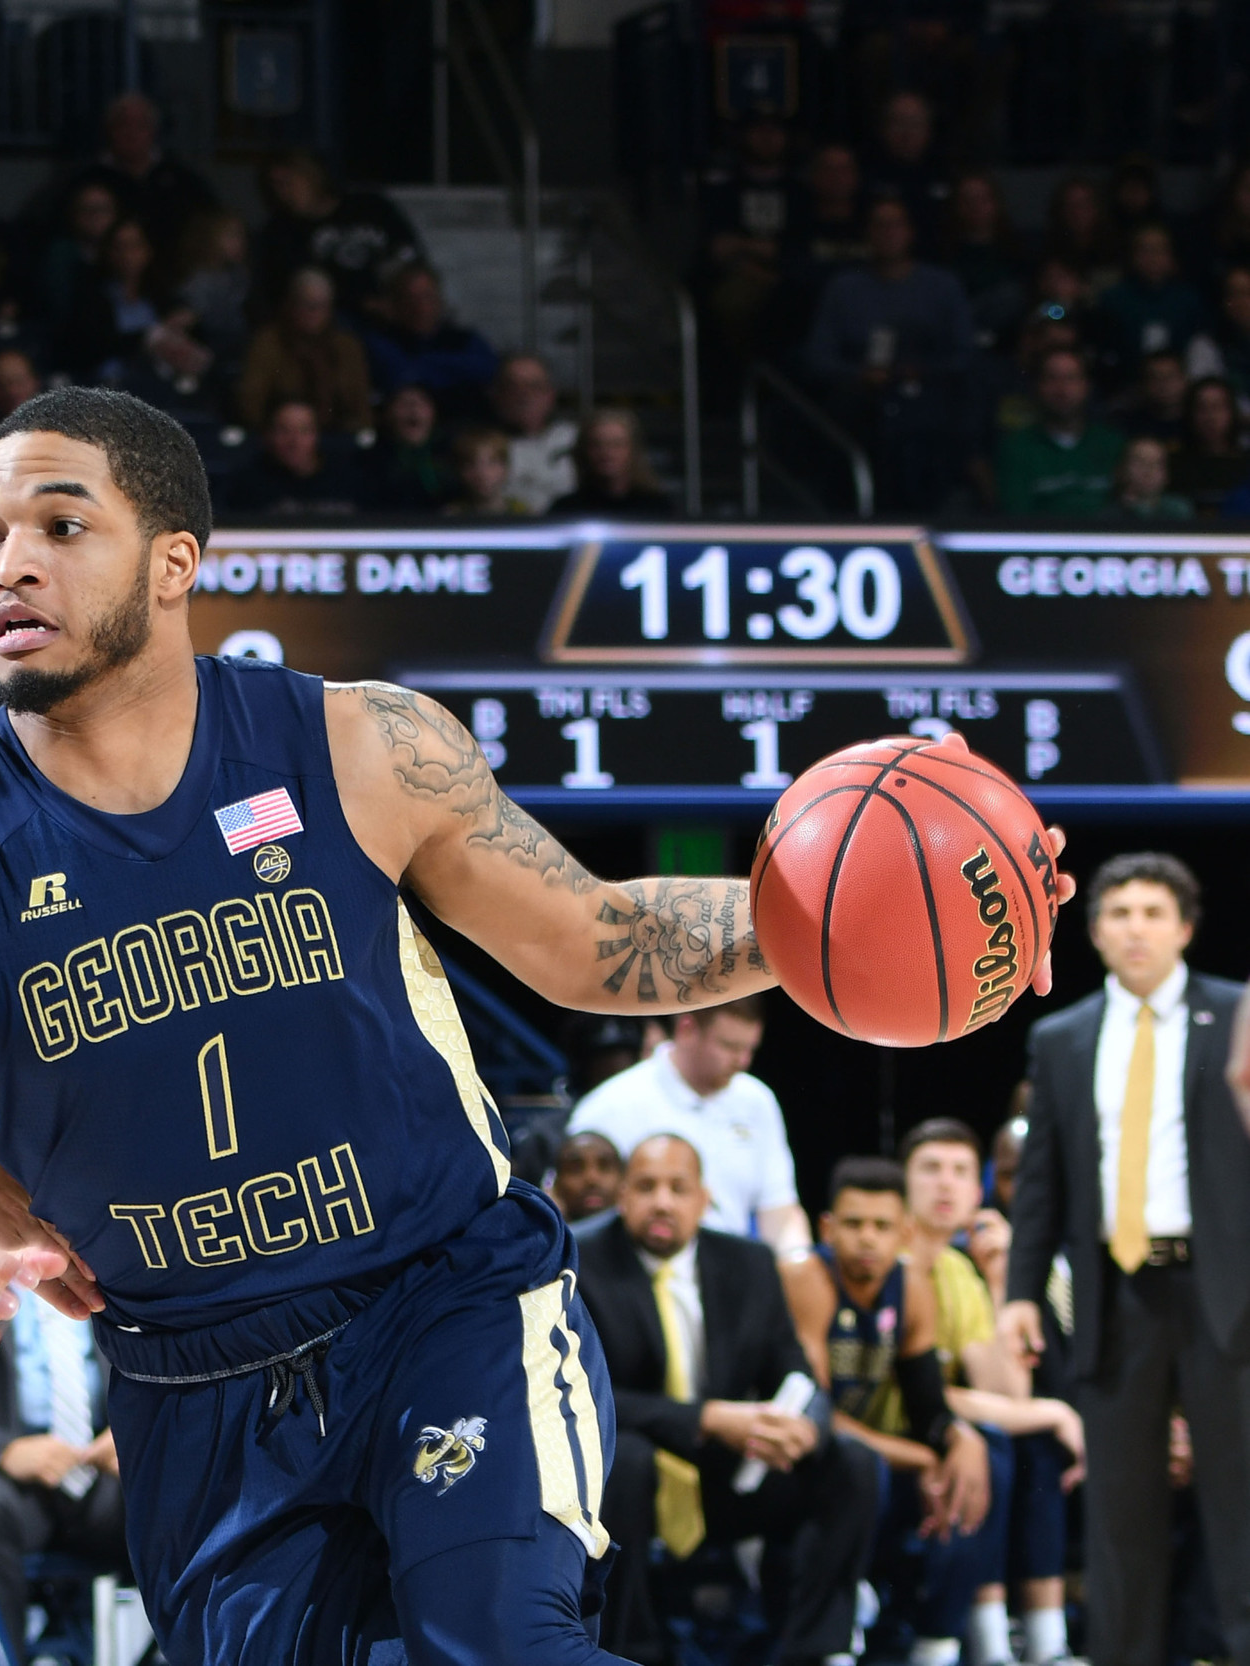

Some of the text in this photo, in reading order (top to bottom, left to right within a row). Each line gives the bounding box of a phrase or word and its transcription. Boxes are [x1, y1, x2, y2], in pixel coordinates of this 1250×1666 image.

[193, 553, 493, 595] NOTRE DAME
[620, 546, 901, 640] 11:30
[998, 556, 1250, 597] GEORGIA T
[472, 699, 507, 739] B
[535, 688, 651, 719] TM FLS
[721, 690, 815, 722] HALF
[883, 689, 999, 719] TM FLS
[1025, 699, 1060, 739] B
[561, 717, 614, 789] 1
[740, 718, 794, 789] 1
[1026, 740, 1061, 780] P
[259, 854, 287, 870] ACC
[28, 872, 67, 908] R
[20, 898, 83, 923] RUSSELL
[960, 846, 1018, 1034] Wilson
[18, 888, 345, 1062] GEORGIA
[197, 1032, 238, 1160] 1
[109, 1143, 375, 1269] TECH
